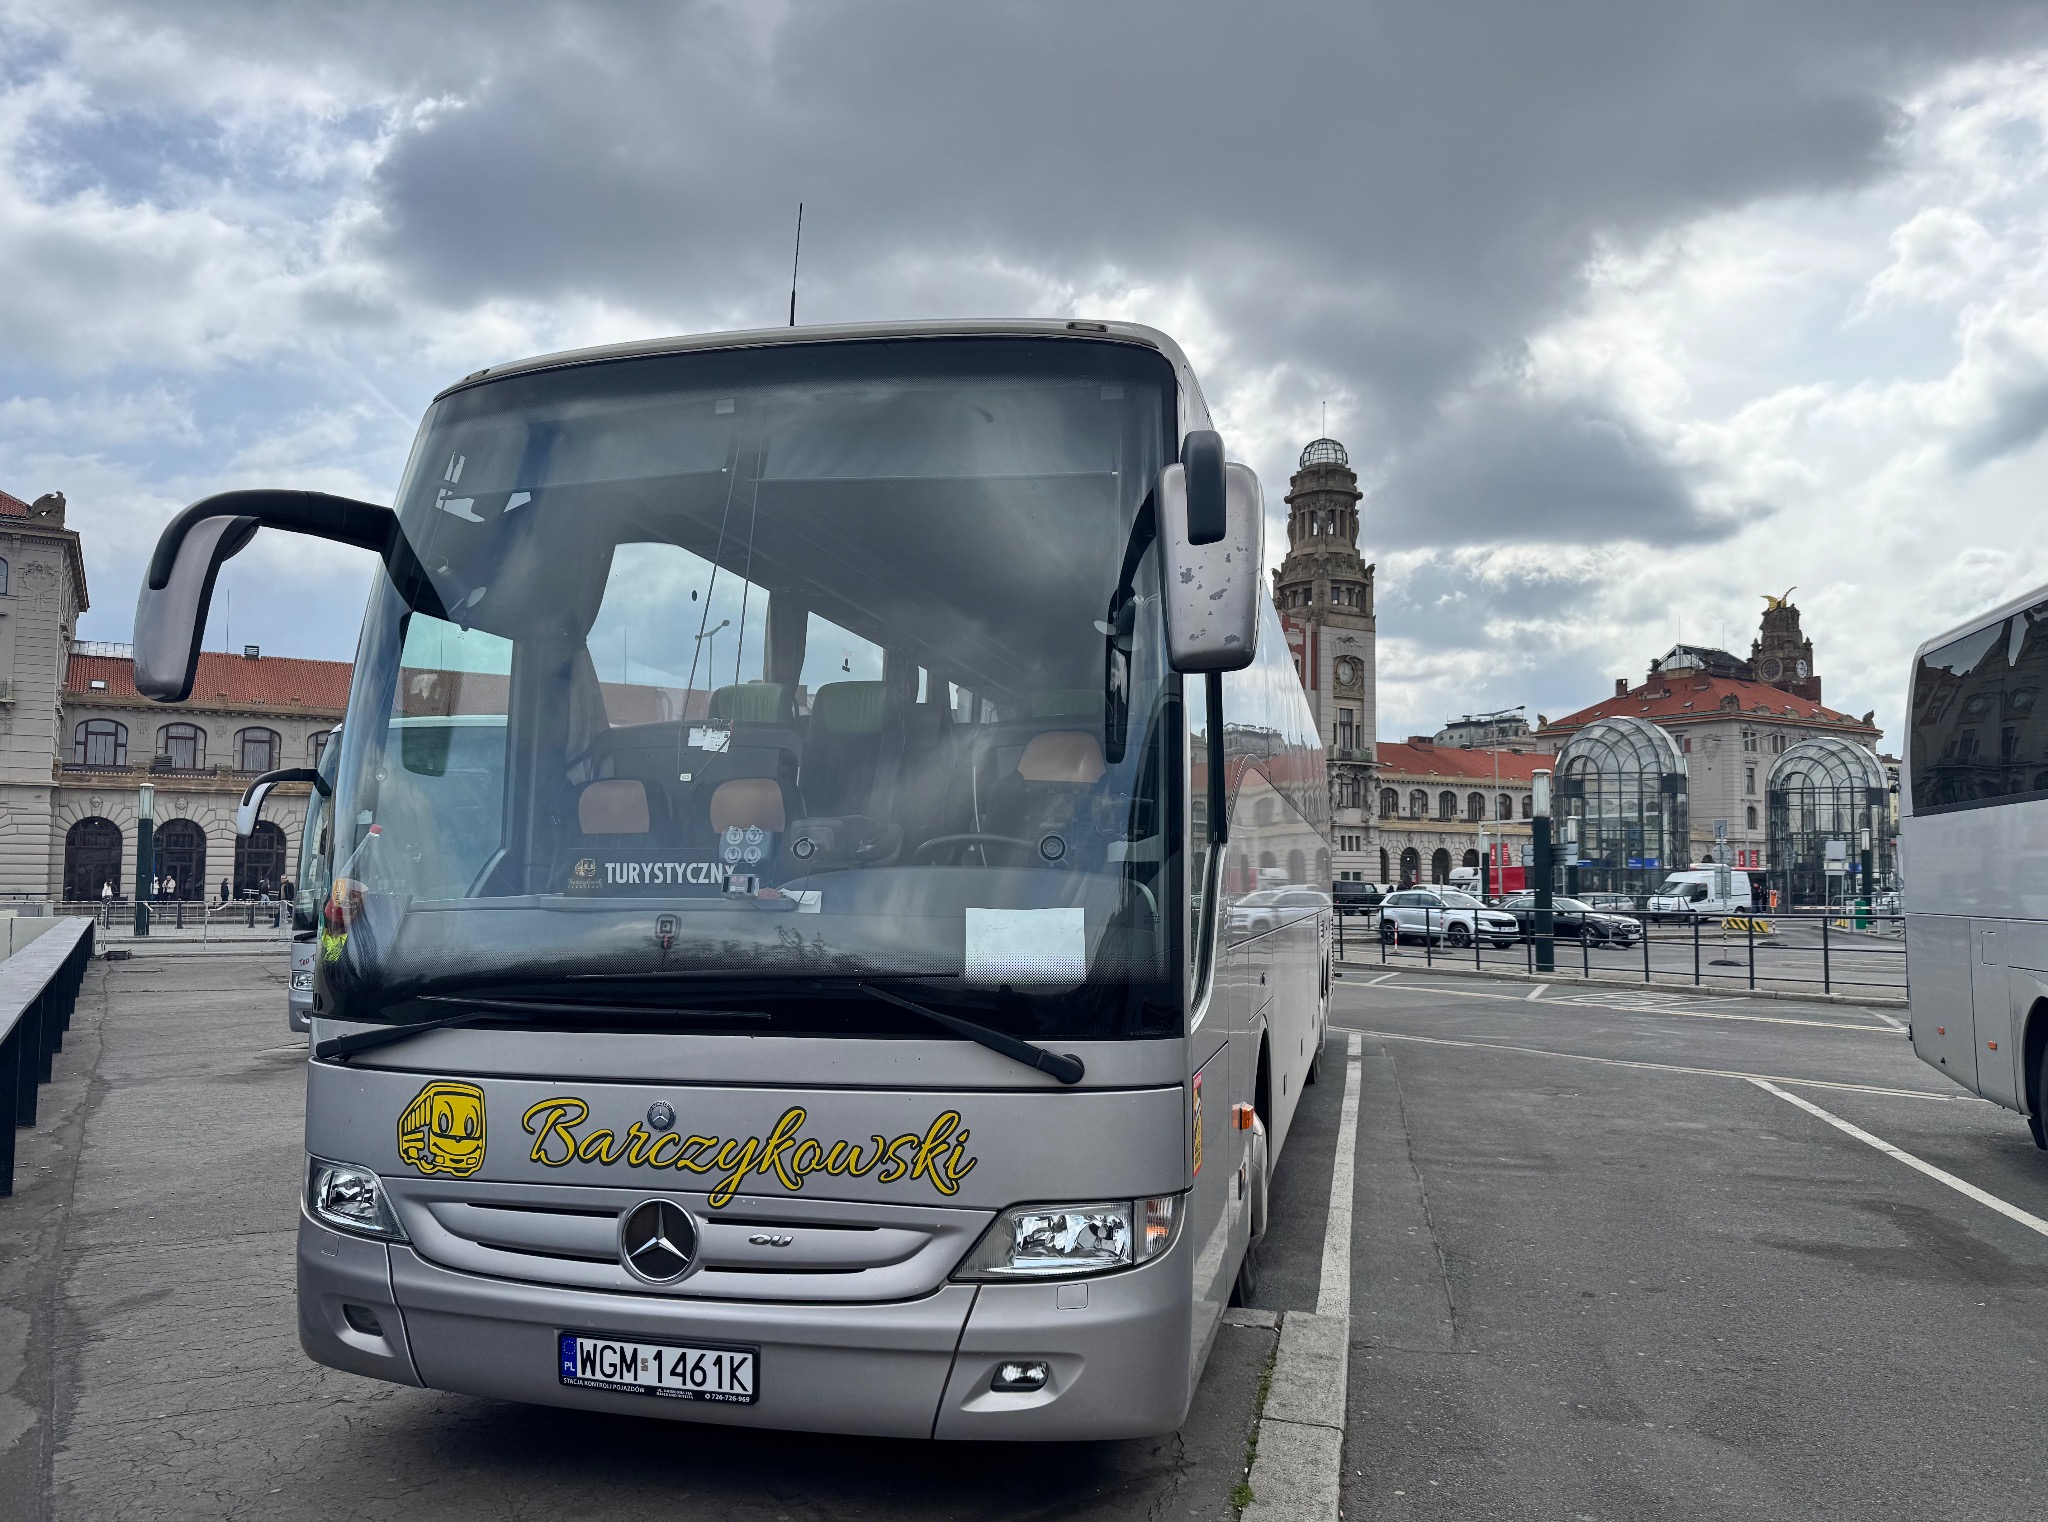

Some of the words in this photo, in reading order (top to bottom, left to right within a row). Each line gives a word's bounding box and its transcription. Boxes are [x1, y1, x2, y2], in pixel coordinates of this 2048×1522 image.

[522, 1096, 977, 1209] Barczykowski
[564, 1361, 576, 1372] PL
[579, 1341, 639, 1382] WGM
[652, 1349, 749, 1393] 1461K
[563, 1377, 584, 1386] STACJA
[584, 1381, 612, 1390] KONTROLI
[612, 1383, 645, 1393] POJAZDÓW
[711, 1393, 750, 1403] 726-726-969
